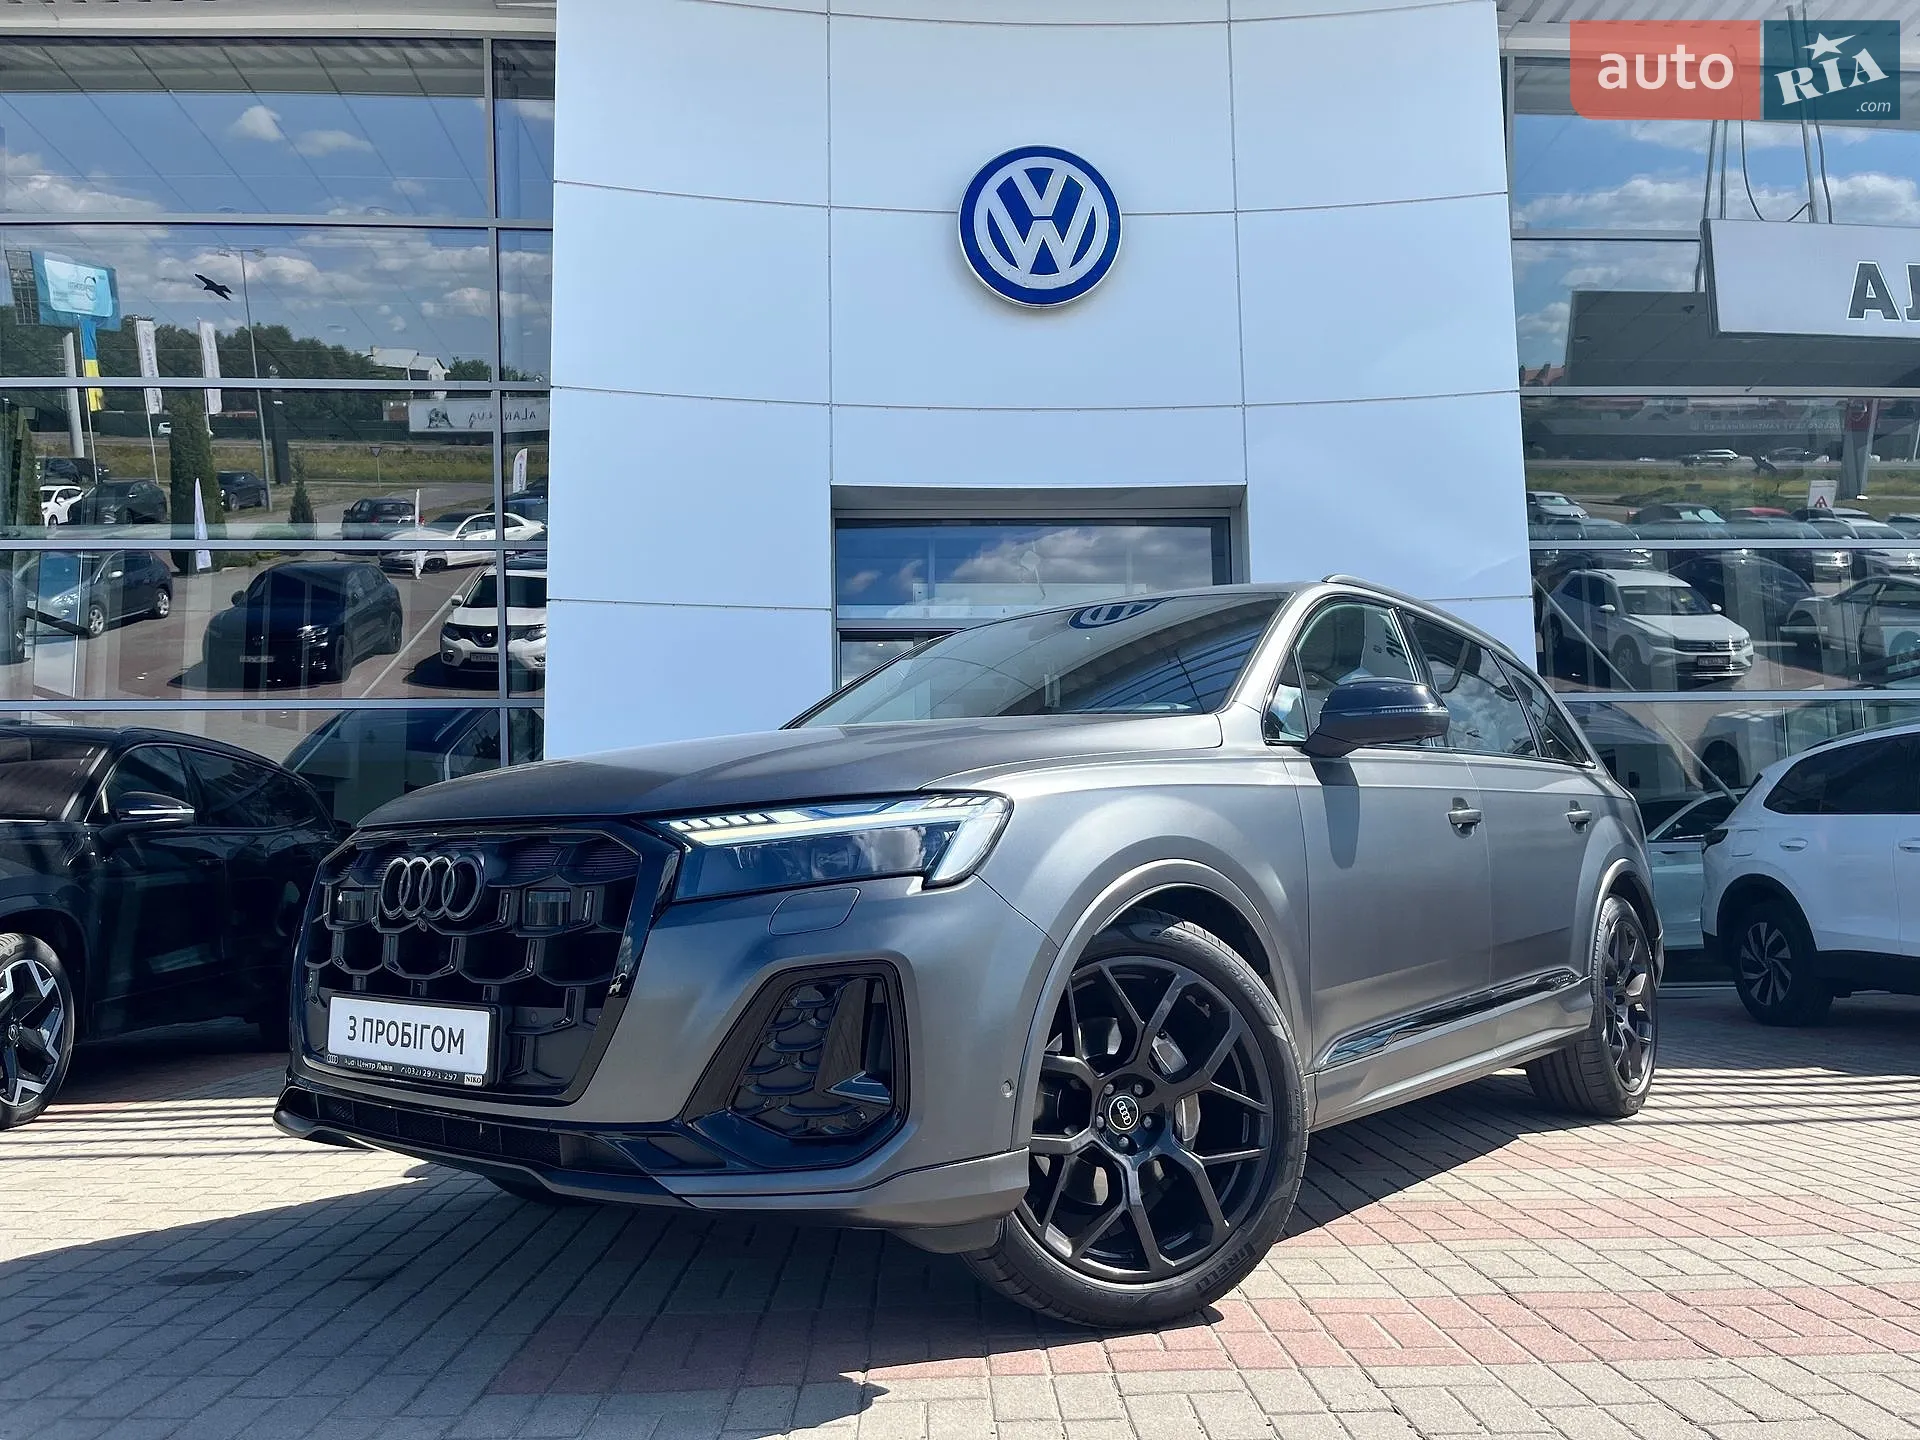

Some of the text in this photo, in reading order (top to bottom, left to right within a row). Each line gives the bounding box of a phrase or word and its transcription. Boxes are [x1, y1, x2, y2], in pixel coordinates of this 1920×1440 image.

[347, 1015, 465, 1055] З ПРОБІГОМ
[465, 1075, 483, 1085] NIKO
[1195, 1241, 1257, 1291] PIRELLI
